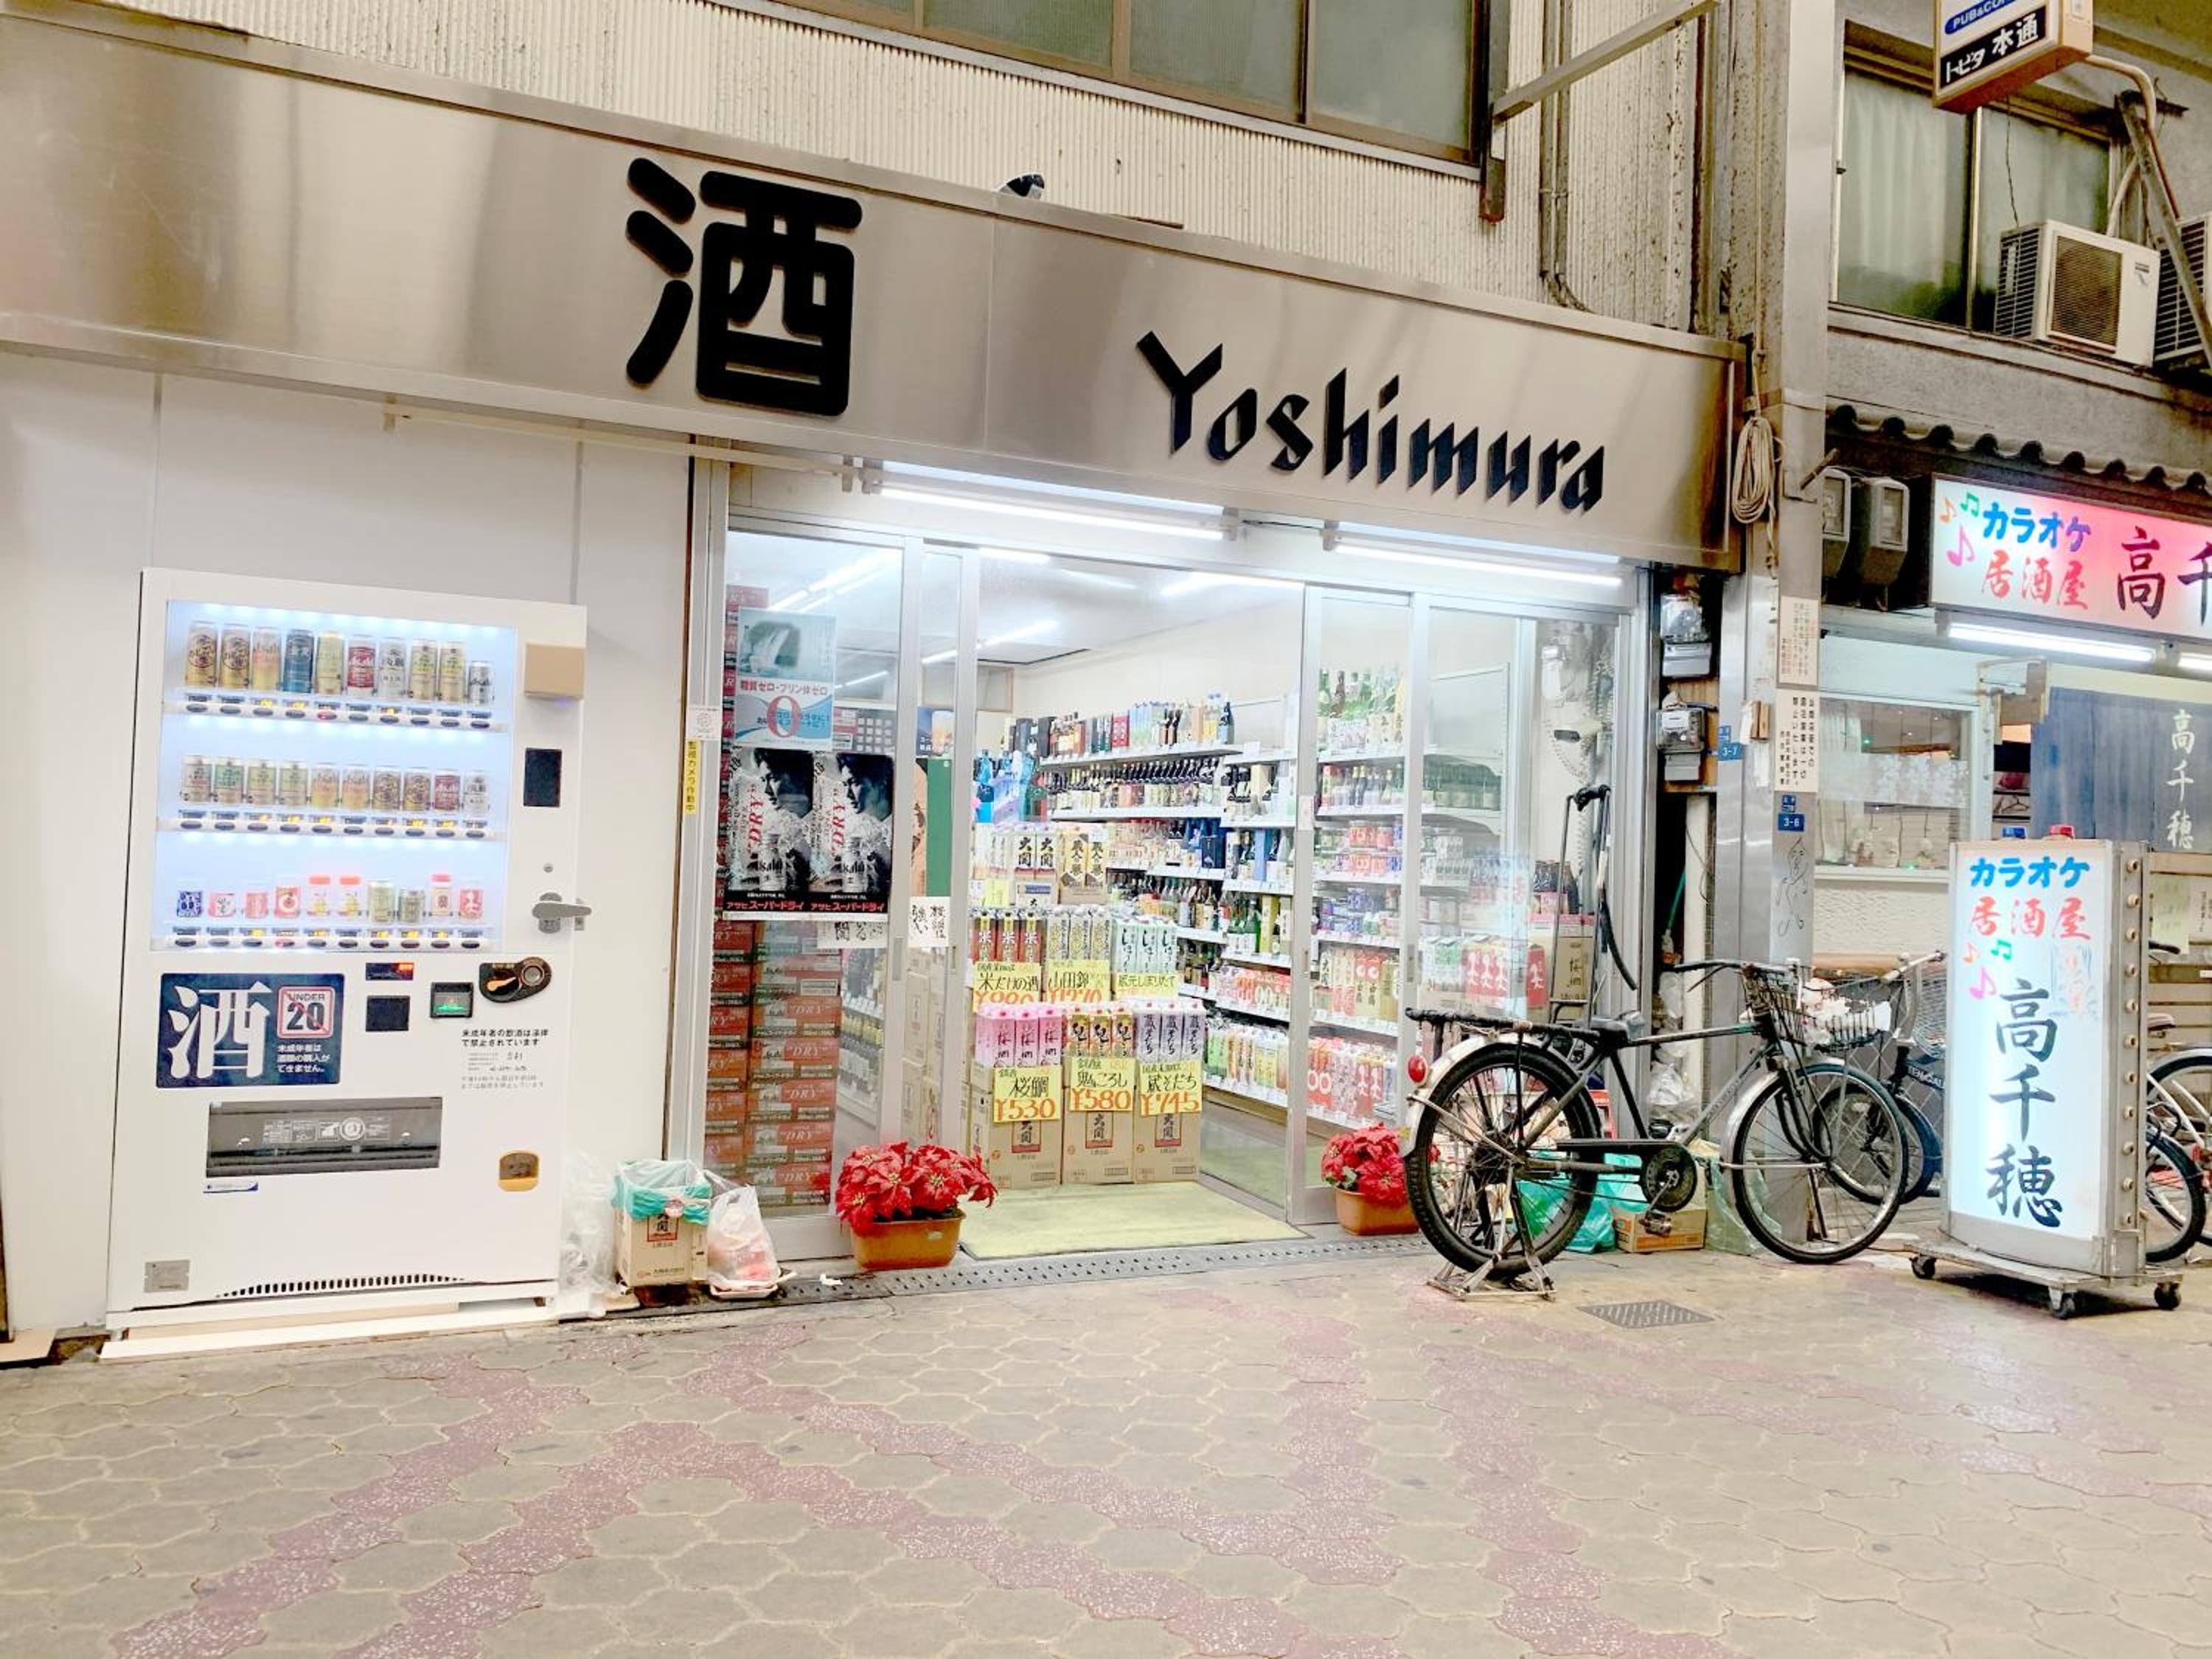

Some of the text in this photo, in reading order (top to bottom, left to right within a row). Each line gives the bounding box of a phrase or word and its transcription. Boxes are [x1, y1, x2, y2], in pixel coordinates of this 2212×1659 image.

[1946, 13, 2039, 83] トビタ 本通
[626, 158, 863, 417] 酒
[1136, 330, 1604, 513] Yoshimura
[1983, 502, 2091, 552] カラオケ
[1981, 549, 2088, 609] 居酒屋
[1722, 746, 1738, 756] 3-7
[2166, 708, 2196, 849] 高千穂
[1784, 818, 1800, 827] 3-6
[1969, 855, 2090, 888] カラオケ
[726, 900, 804, 911] アサヒスーパードライ
[810, 902, 886, 911] アサヒスーパードライ
[1969, 896, 2091, 940] 居酒屋
[288, 993, 325, 1001] UNDER
[978, 972, 1040, 992] 米だけの酒
[167, 981, 272, 1079] 酒
[286, 1002, 325, 1031] 20
[277, 1063, 325, 1073] できません。
[995, 1097, 1056, 1121] ¥530
[1070, 1088, 1132, 1110] ¥580
[1986, 978, 2062, 1228] 高千穂
